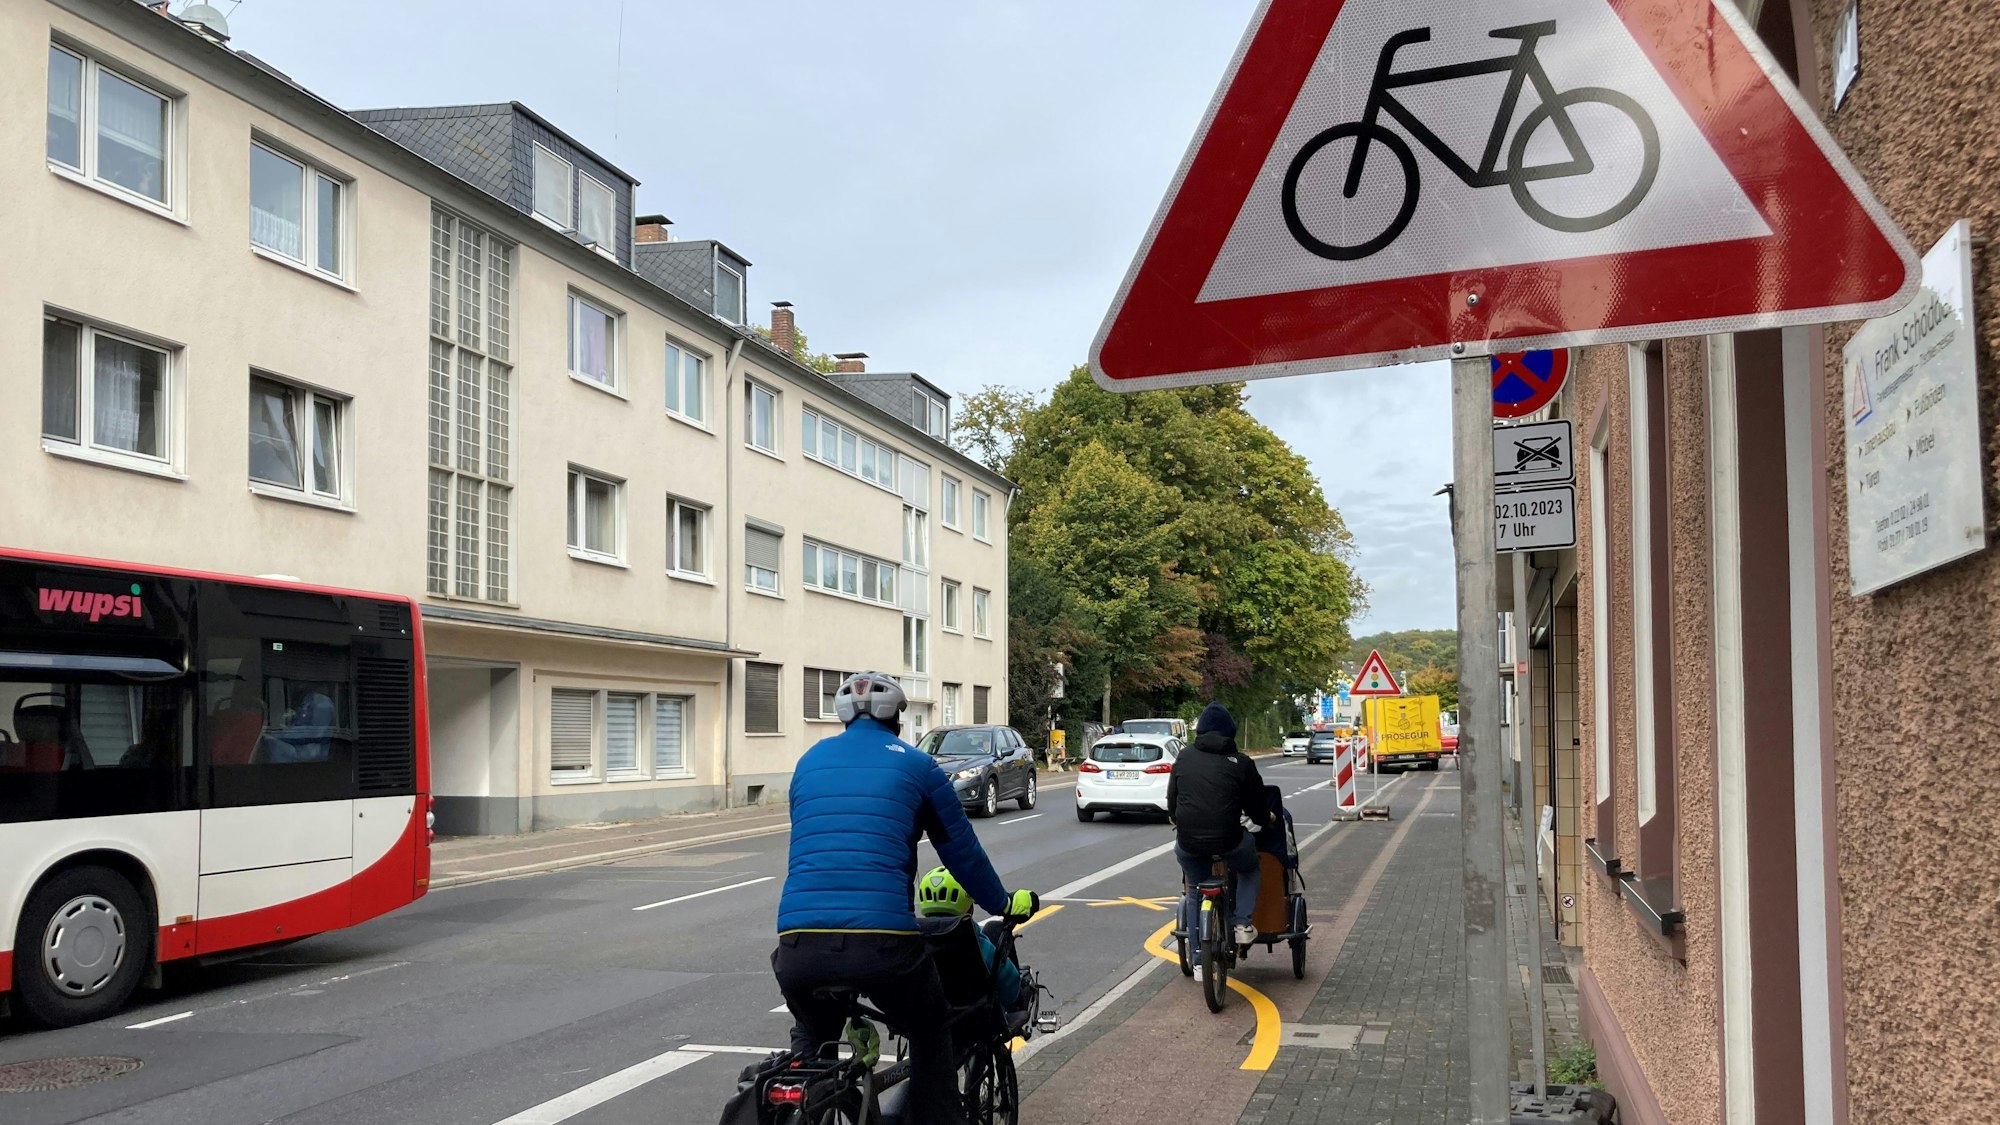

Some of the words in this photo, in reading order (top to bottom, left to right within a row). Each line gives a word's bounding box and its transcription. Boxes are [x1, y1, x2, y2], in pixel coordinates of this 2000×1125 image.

[1875, 332, 1899, 380] Frank
[1495, 499, 1562, 519] 02.10.2023
[1500, 524, 1506, 538] 7
[1513, 522, 1536, 537] Uhr
[39, 584, 141, 622] wupsi
[1381, 731, 1429, 741] PROSEGUR
